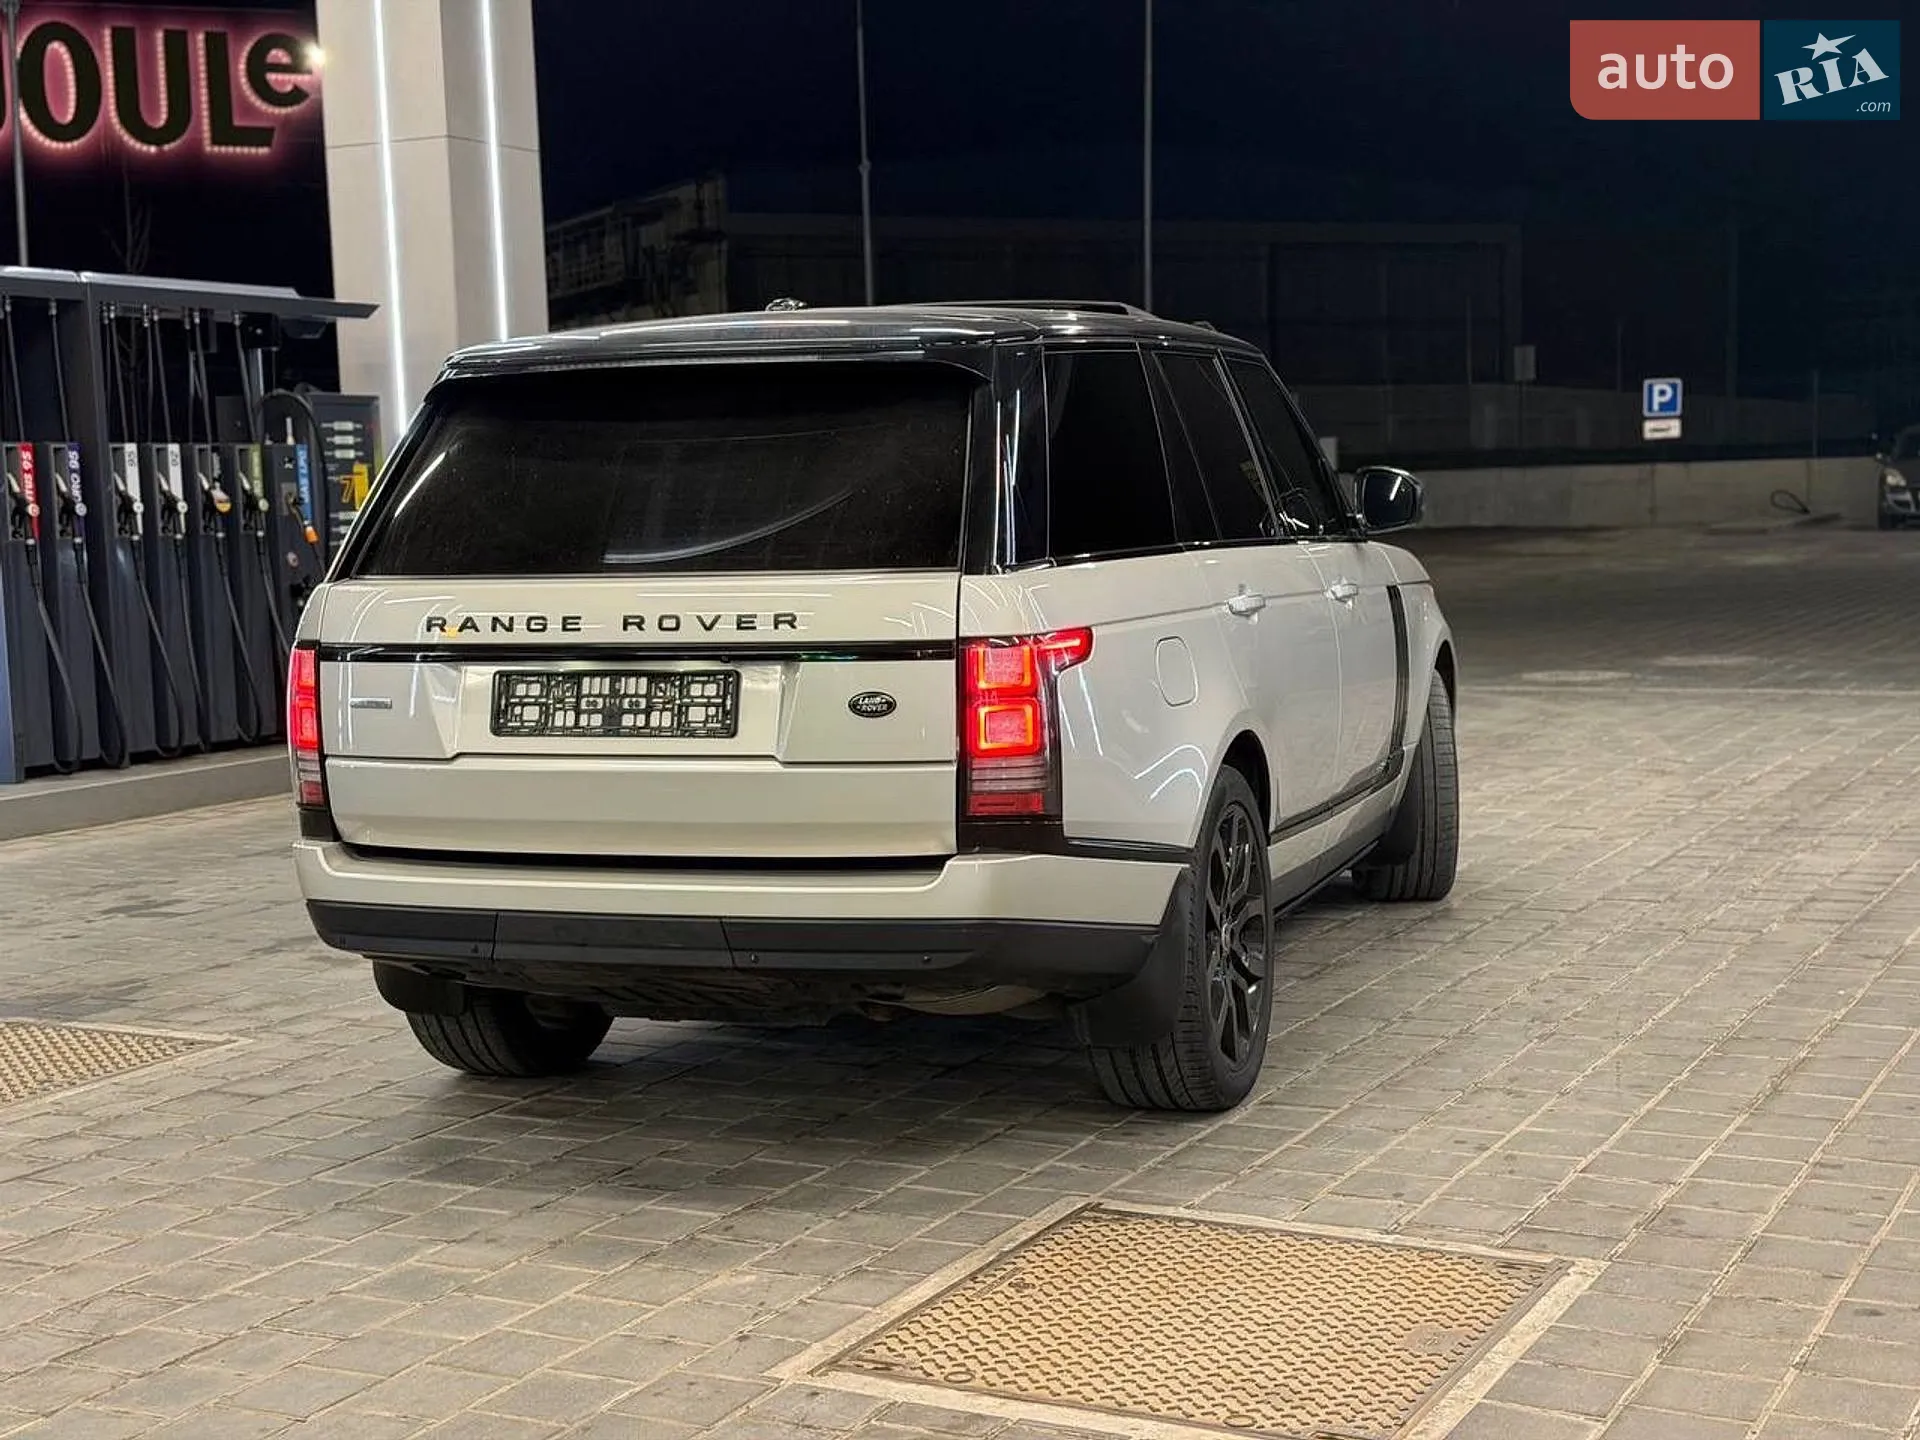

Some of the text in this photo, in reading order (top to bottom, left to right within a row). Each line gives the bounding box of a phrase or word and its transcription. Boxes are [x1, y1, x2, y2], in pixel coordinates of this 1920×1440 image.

[0, 21, 313, 147] OULe
[1652, 383, 1673, 412] P
[68, 450, 80, 469] 95
[425, 613, 799, 633] RANGE ROVER
